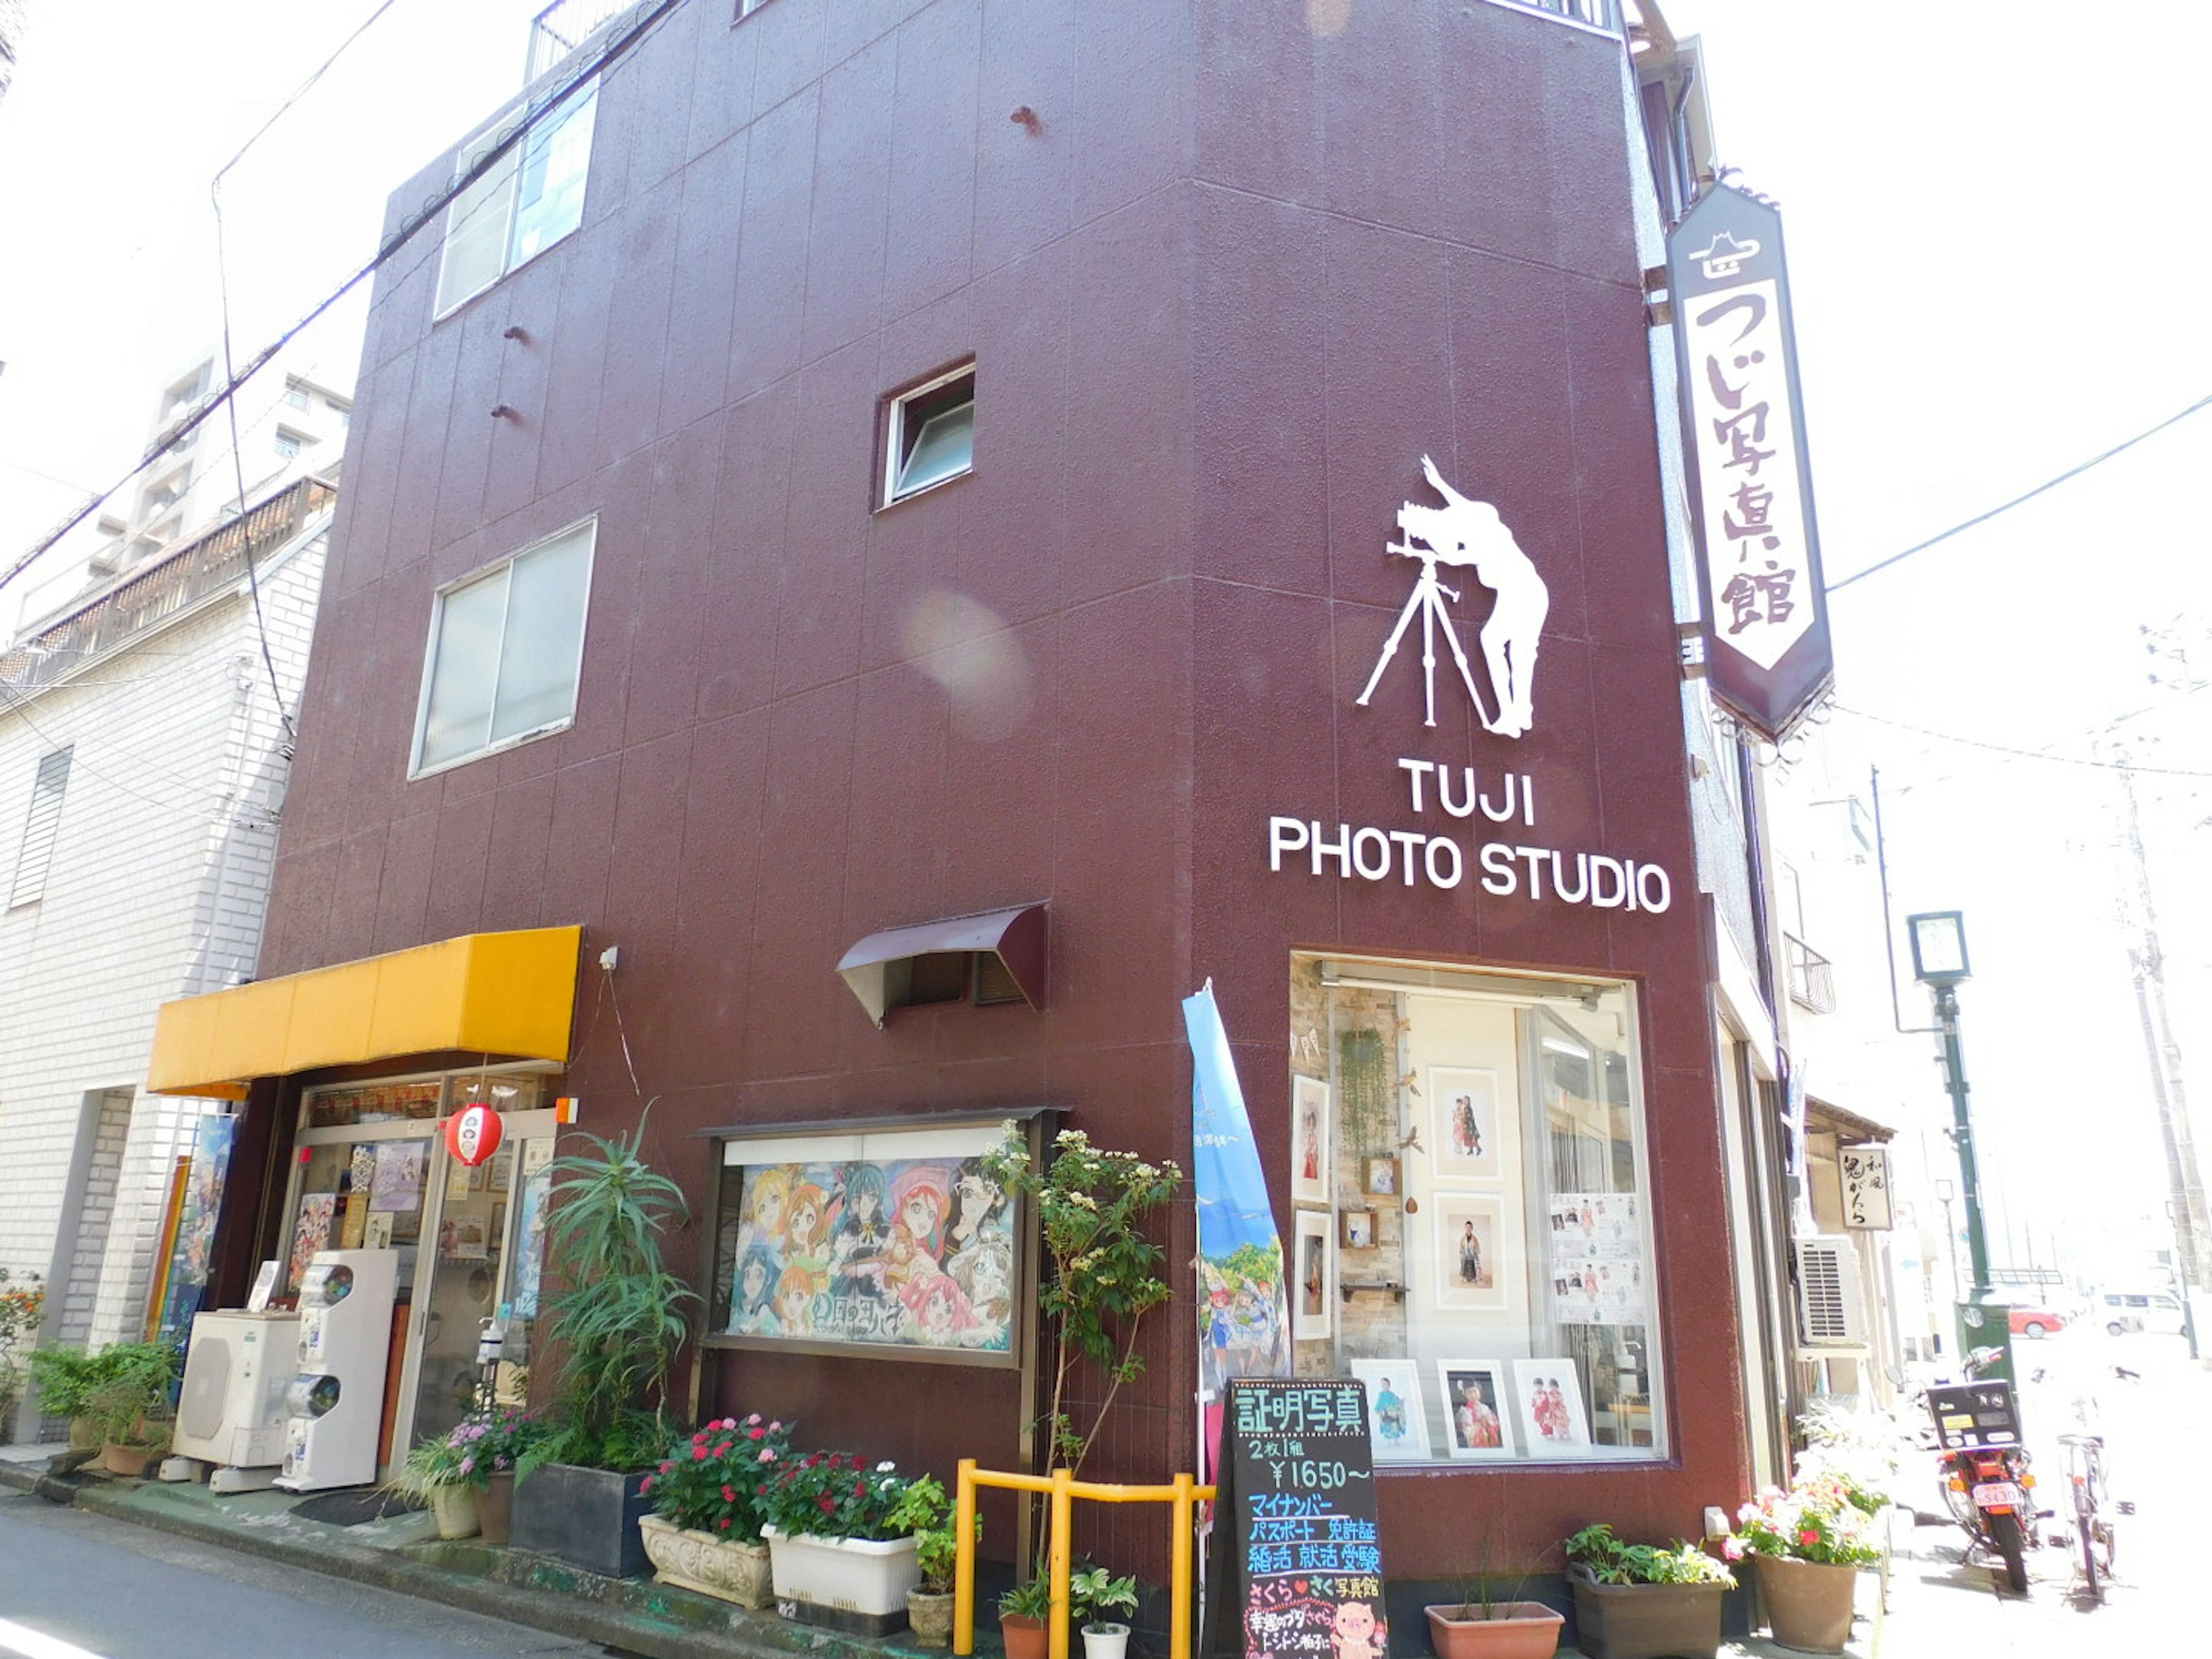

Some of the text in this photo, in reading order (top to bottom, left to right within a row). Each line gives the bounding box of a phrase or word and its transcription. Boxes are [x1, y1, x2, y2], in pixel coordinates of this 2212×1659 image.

[1398, 758, 1534, 825] TUJI
[1270, 816, 1671, 914] PHOTO STUDIO
[1234, 1387, 1362, 1434] 証明写真
[1248, 1439, 1305, 1459] 2枚1組
[1248, 1493, 1332, 1516] マイナンバー
[1249, 1517, 1376, 1541] パスポート 免許証
[1298, 1544, 1338, 1568] 就活
[1341, 1544, 1381, 1573] 受験
[1250, 1579, 1293, 1605] さくら
